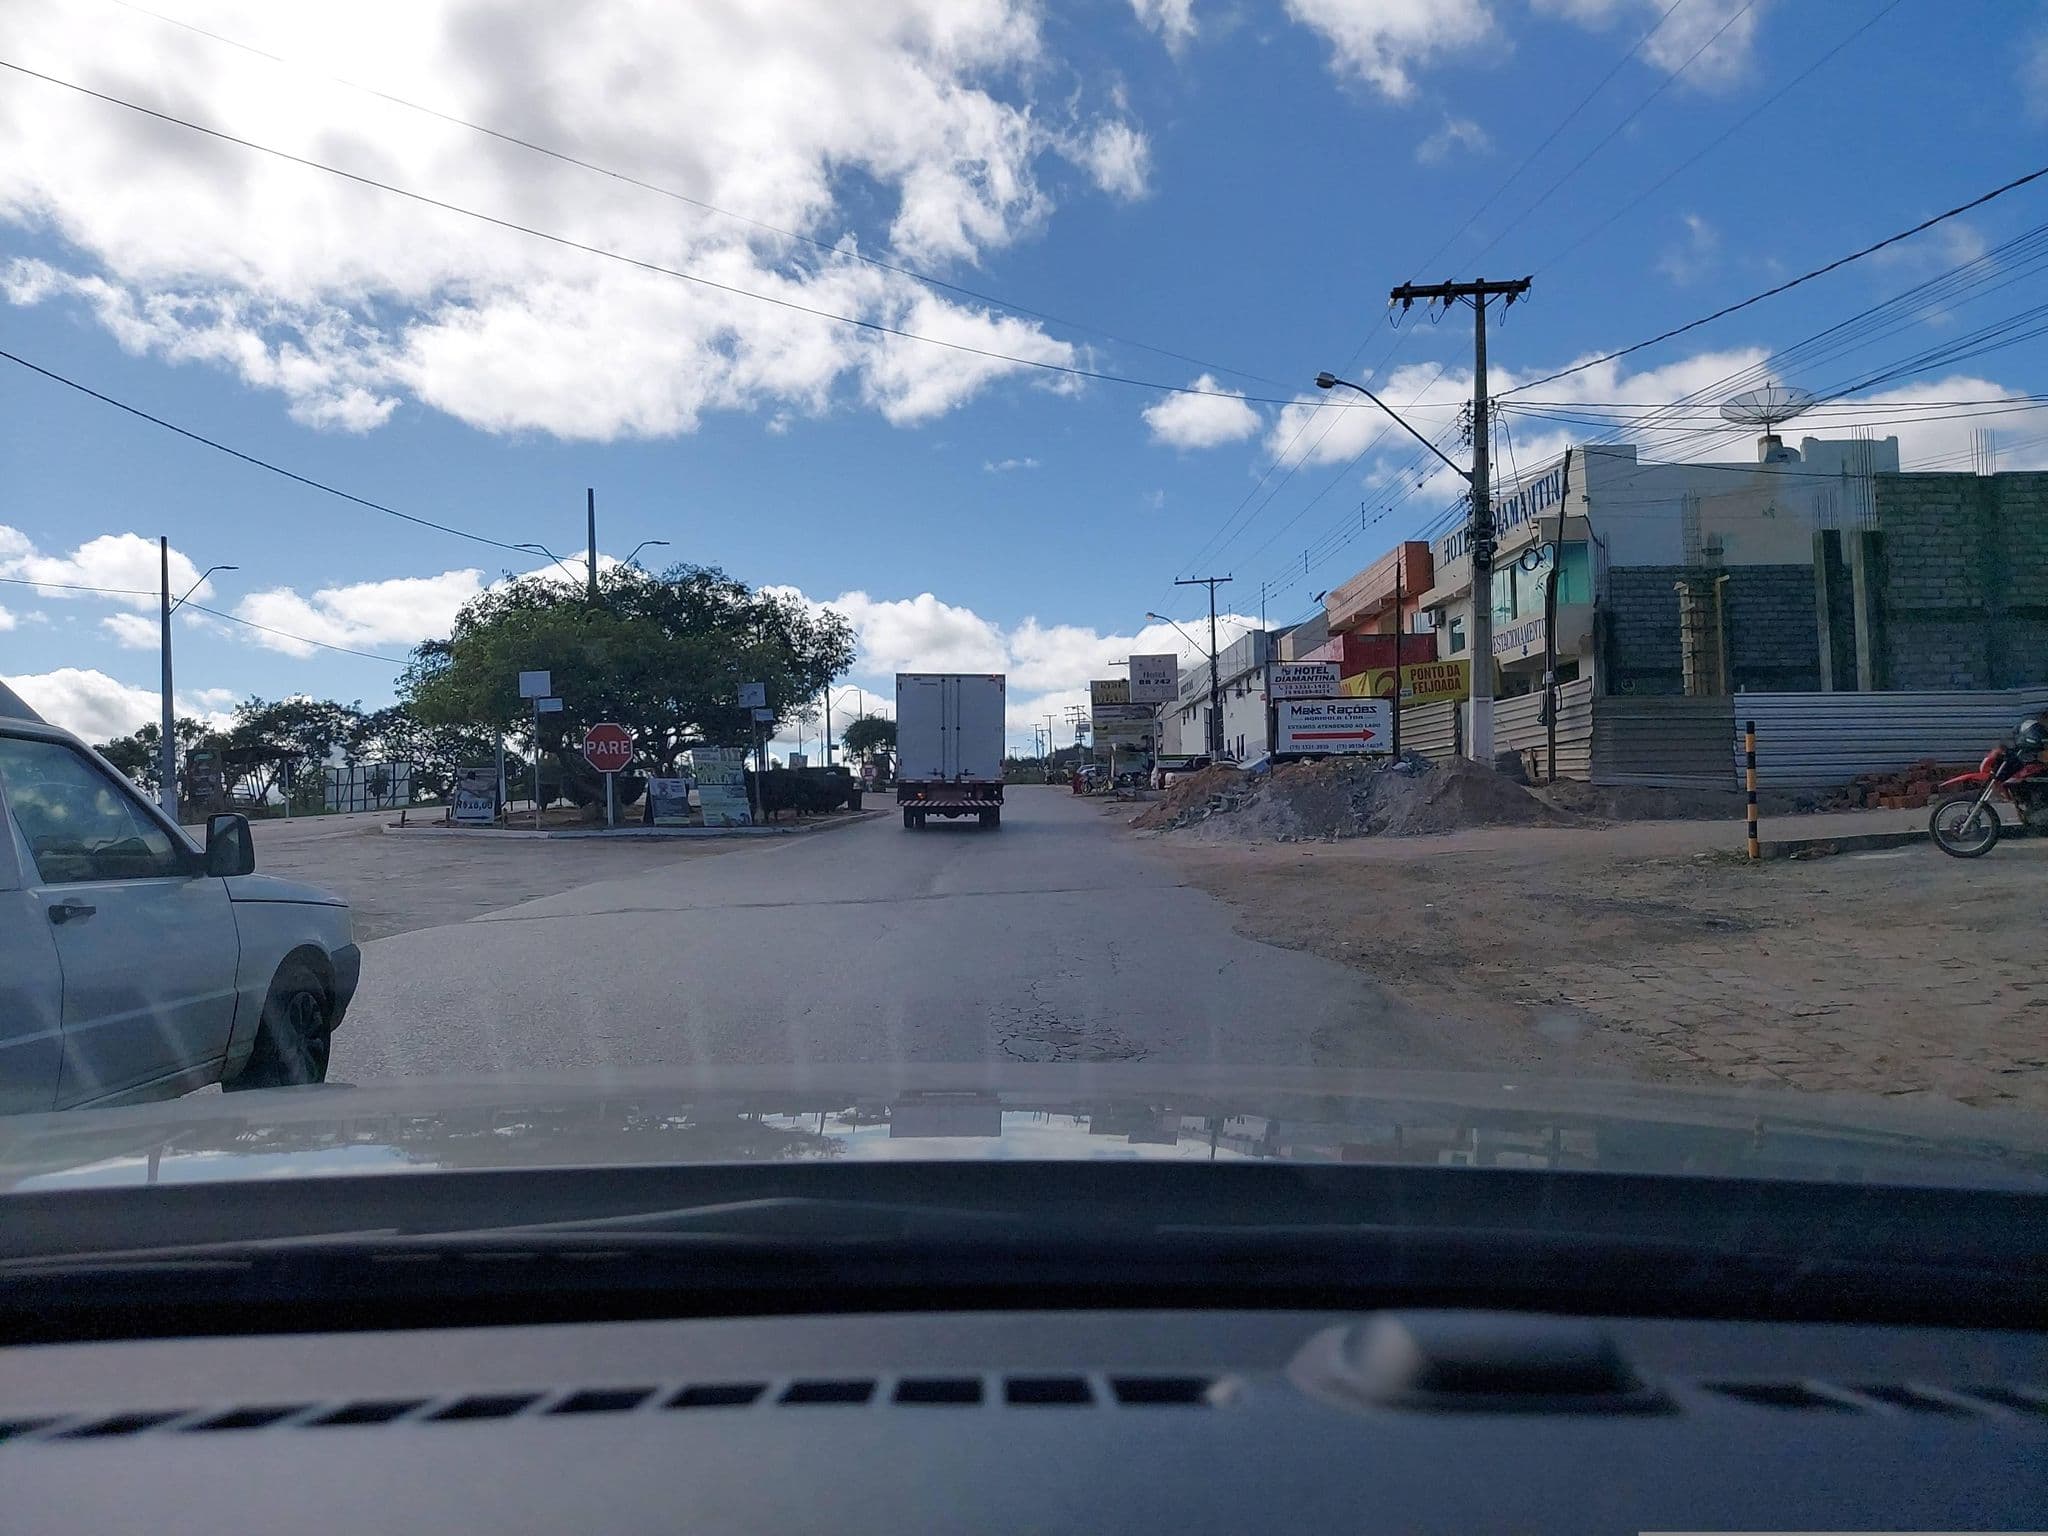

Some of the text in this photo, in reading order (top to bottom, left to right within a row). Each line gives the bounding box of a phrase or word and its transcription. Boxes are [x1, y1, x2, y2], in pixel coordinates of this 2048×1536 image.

[1443, 468, 1563, 566] HOTE DIAMANTIN
[1294, 666, 1329, 675] HOTEL
[1410, 664, 1461, 681] PONTO DA
[1275, 675, 1336, 683] DIAMANTINA
[1413, 678, 1461, 694] FEIJOADA
[1291, 704, 1377, 716] Mais Rações
[586, 740, 631, 755] PARE
